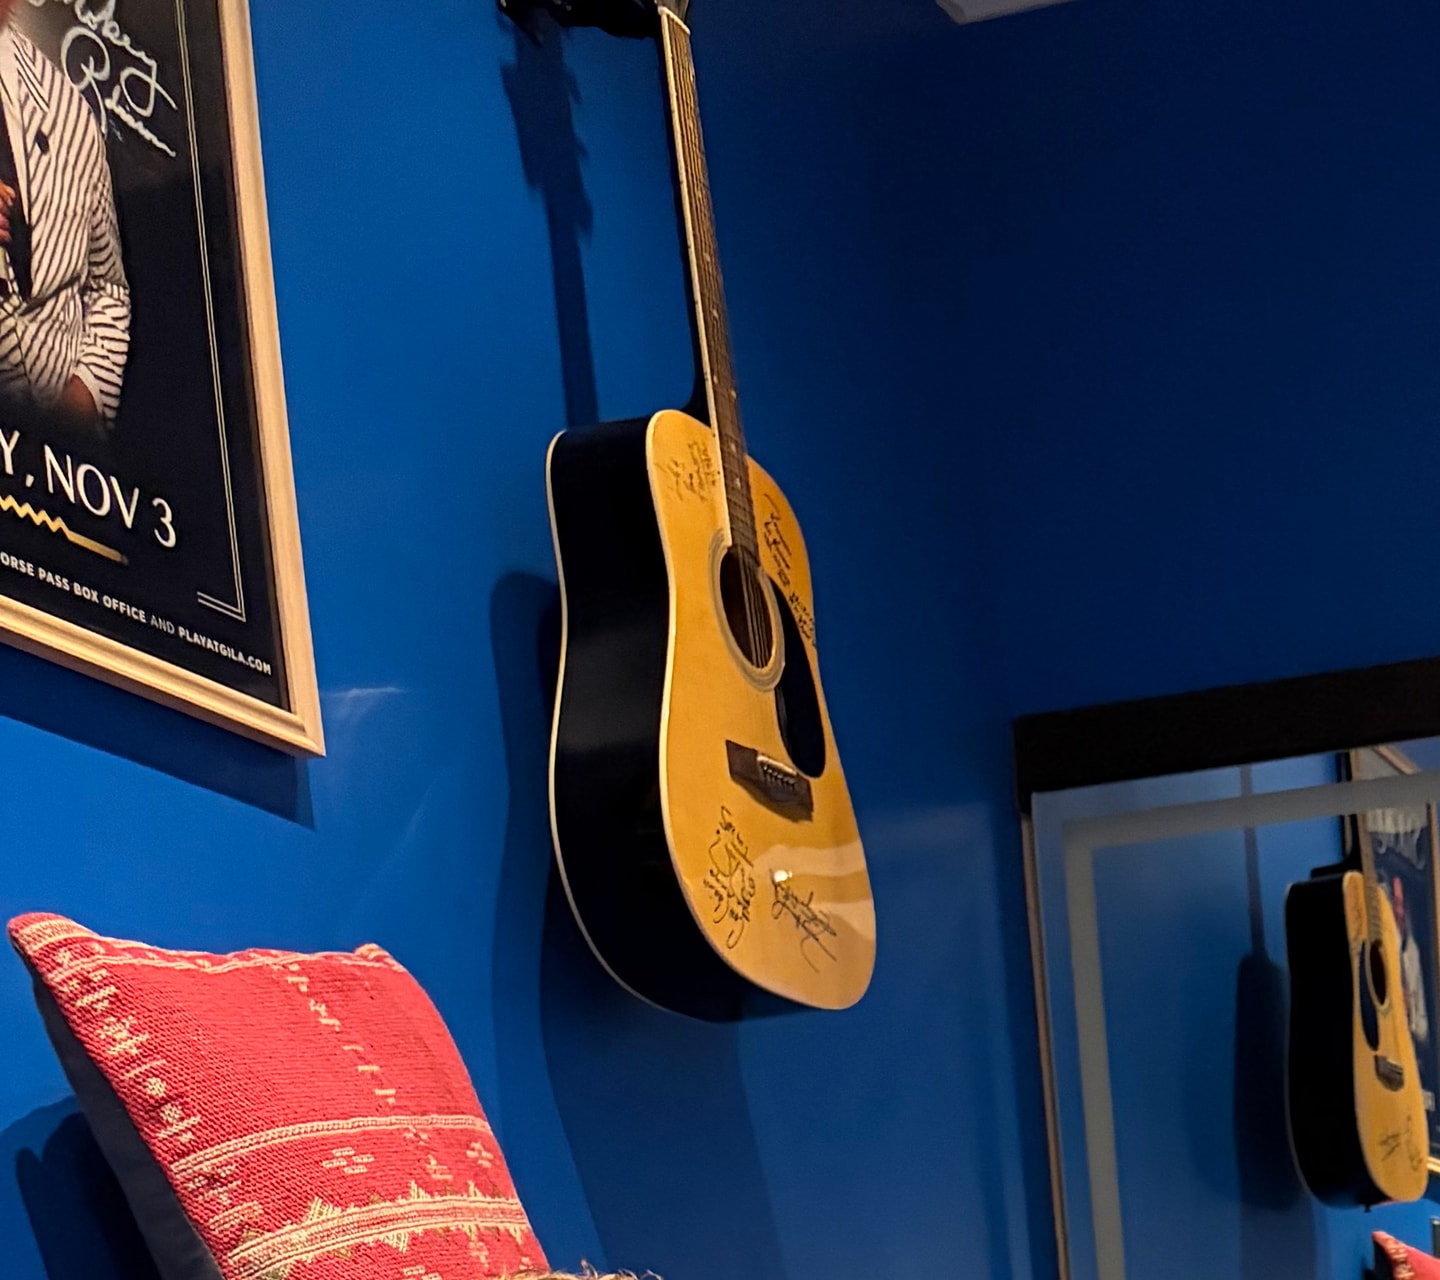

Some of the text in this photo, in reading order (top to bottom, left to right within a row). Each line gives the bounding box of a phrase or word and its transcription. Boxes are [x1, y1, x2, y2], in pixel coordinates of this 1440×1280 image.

[44, 444, 140, 529] NOV
[152, 497, 177, 548] 3
[38, 567, 71, 592] PASS
[72, 581, 100, 604] BOX
[102, 594, 147, 624] OFFICE
[150, 615, 176, 635] AND
[178, 625, 272, 676] PLAYATGILA.COM
